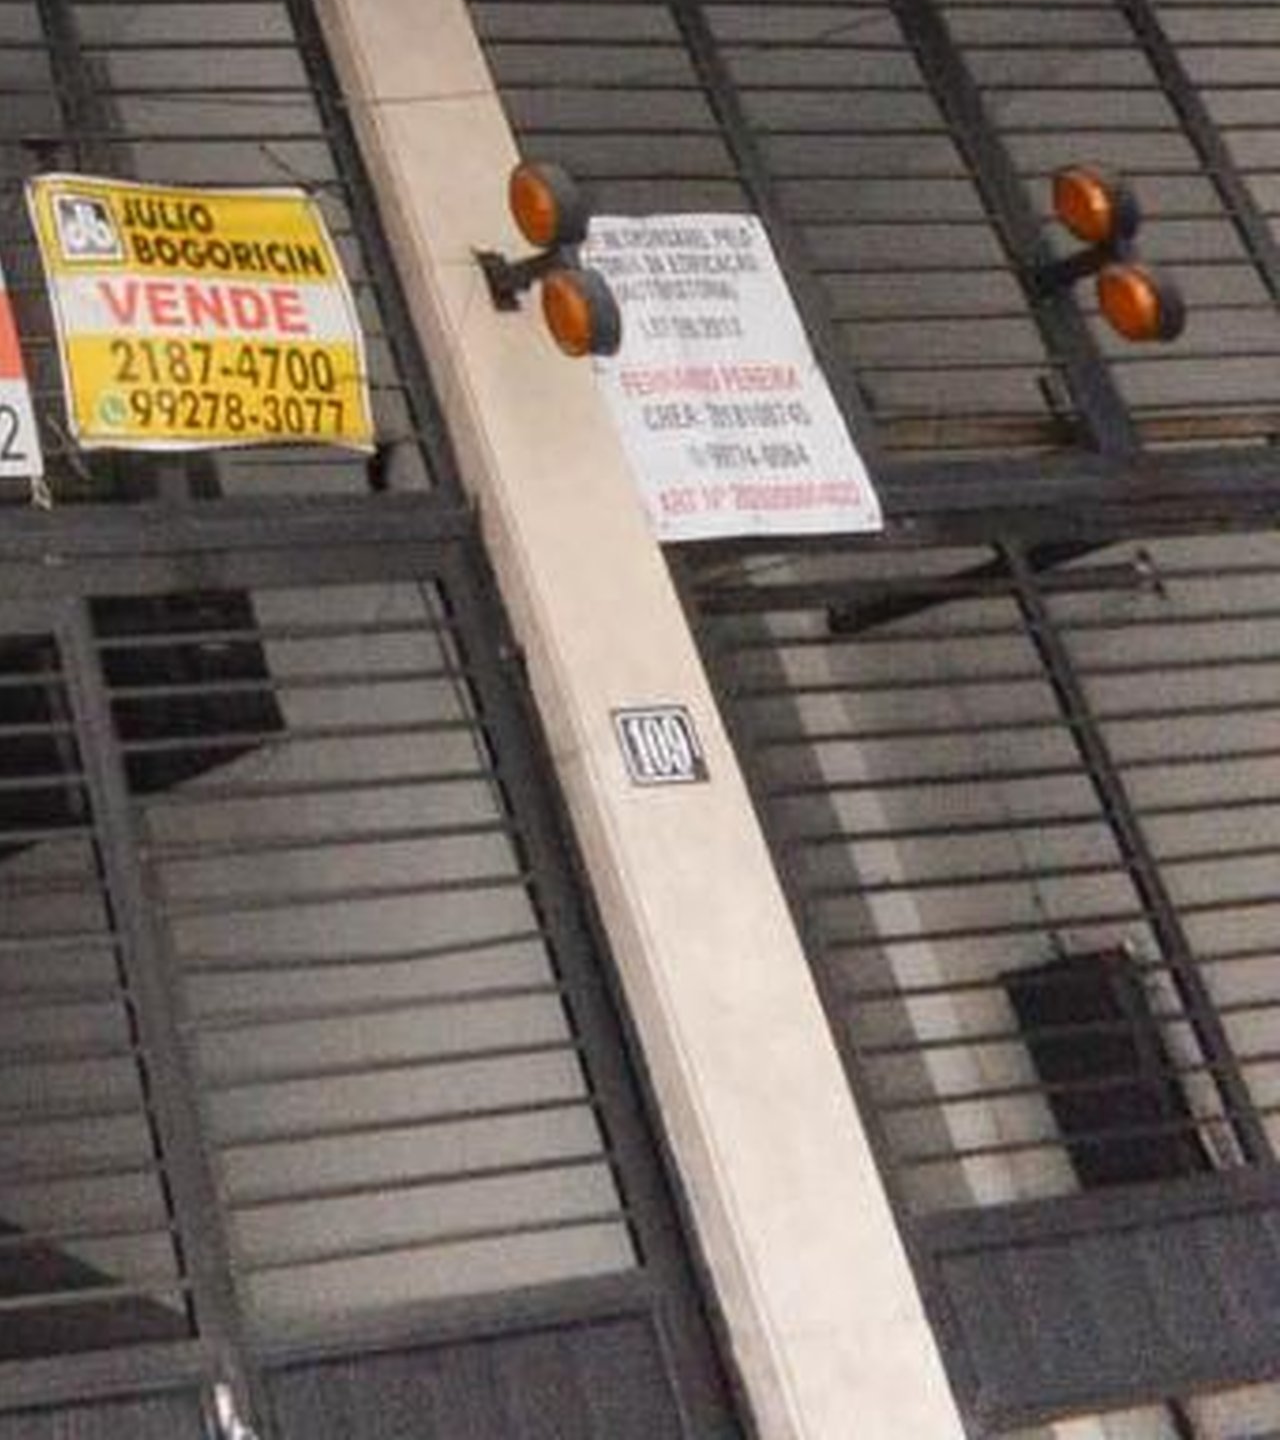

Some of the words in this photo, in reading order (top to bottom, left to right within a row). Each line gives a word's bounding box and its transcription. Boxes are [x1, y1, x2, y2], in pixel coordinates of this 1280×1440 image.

[120, 198, 214, 234] JULIO
[130, 234, 328, 277] BOGORICIN
[98, 281, 309, 335] VENDE
[110, 339, 335, 394] 2187-4700
[130, 388, 344, 436] 99278-3077
